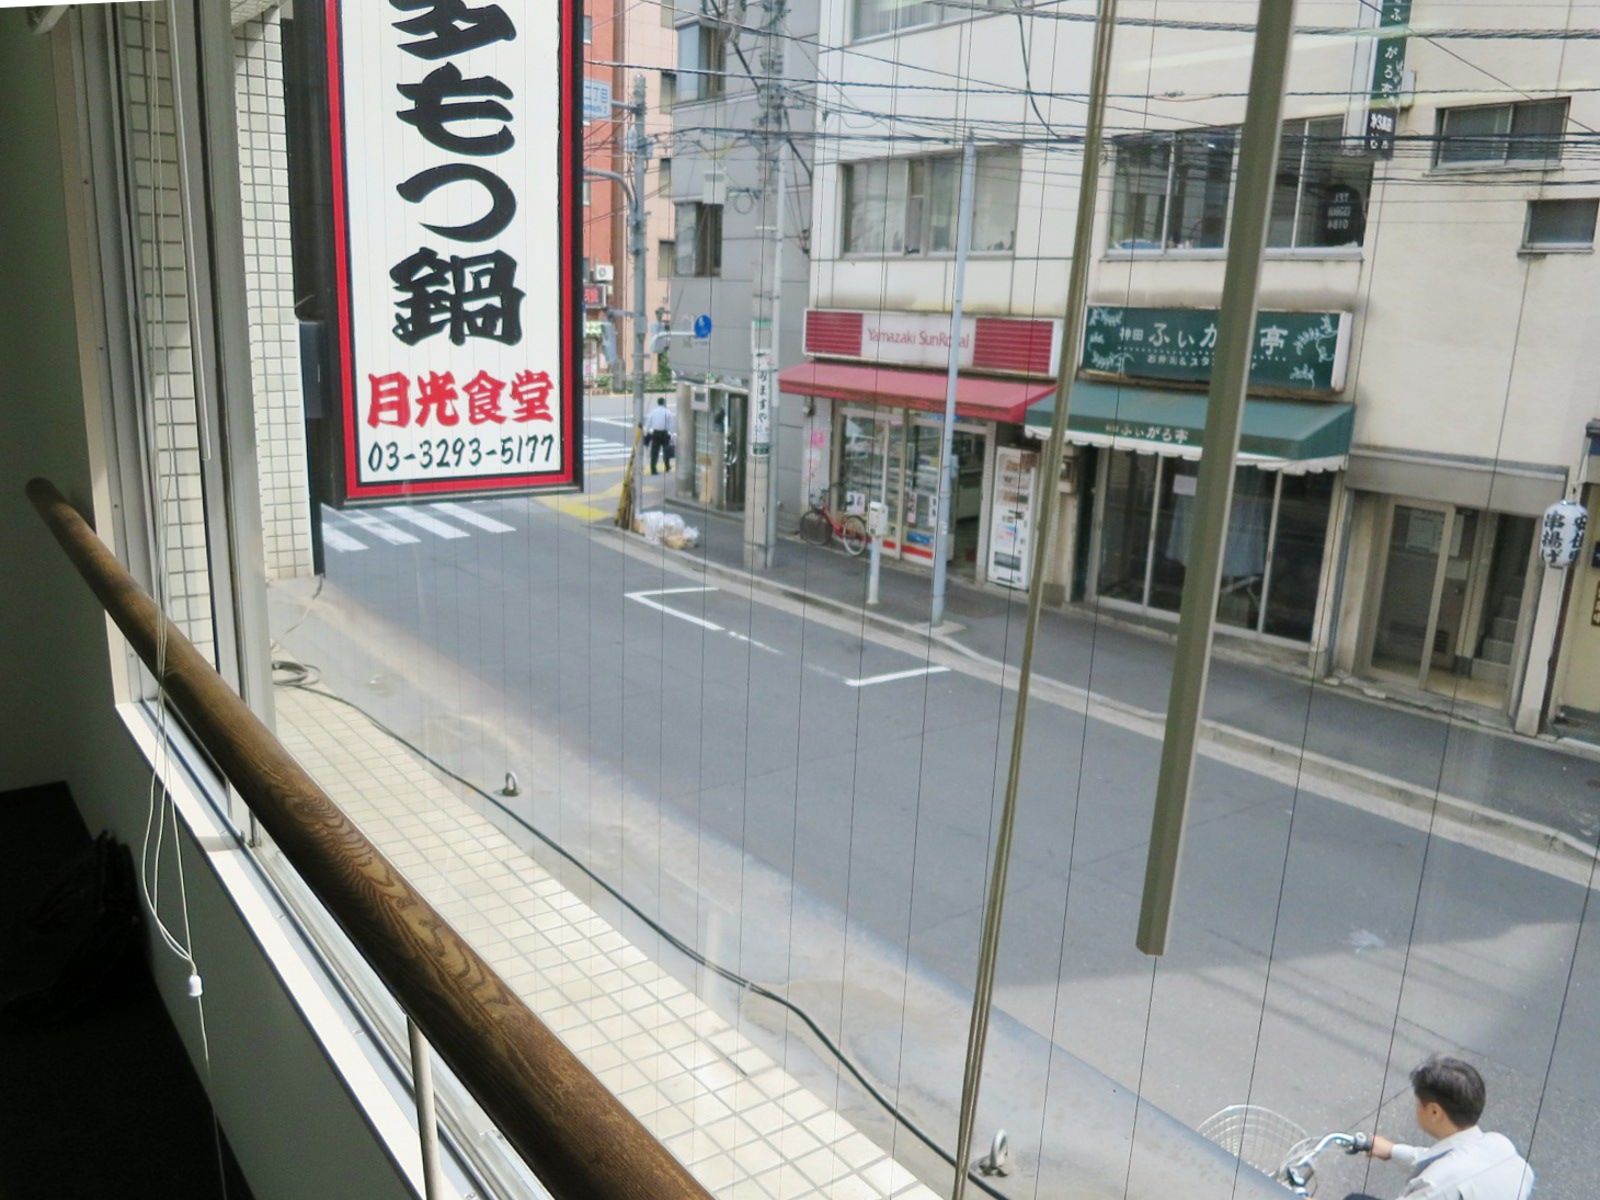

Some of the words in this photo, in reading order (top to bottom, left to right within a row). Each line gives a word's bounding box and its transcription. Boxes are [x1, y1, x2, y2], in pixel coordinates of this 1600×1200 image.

[867, 328, 916, 345] Yamazaki
[918, 330, 970, 349] SunRoal
[366, 369, 556, 429] 月光食堂
[367, 433, 556, 473] 03-3293-5177
